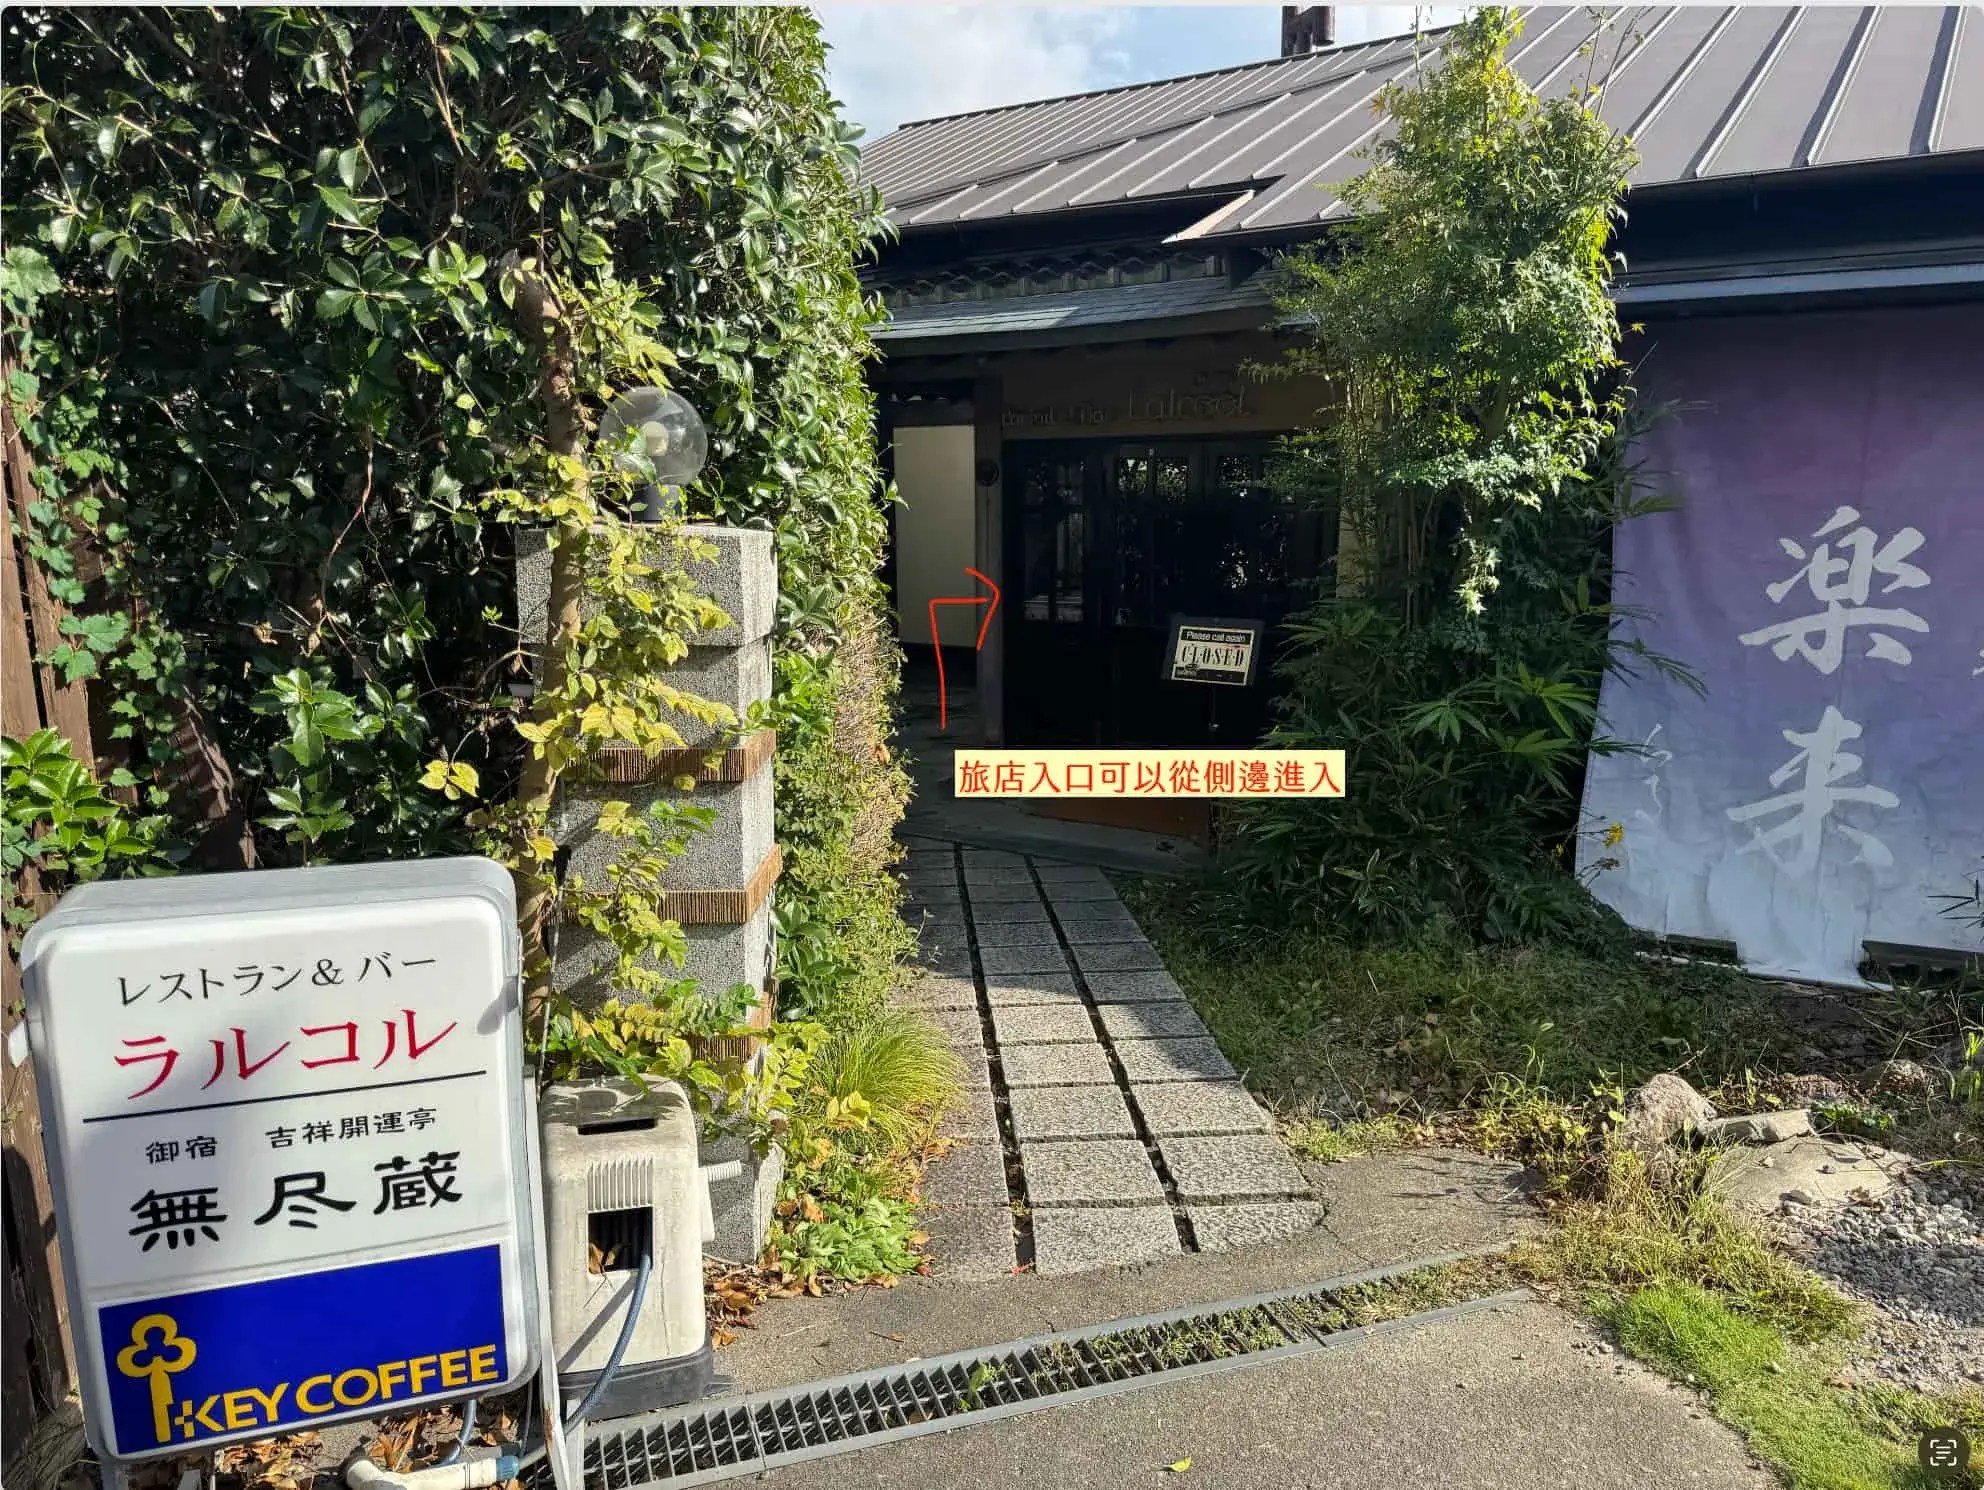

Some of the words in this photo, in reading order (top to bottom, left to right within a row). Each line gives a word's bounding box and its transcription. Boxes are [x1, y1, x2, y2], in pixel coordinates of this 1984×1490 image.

[113, 1008, 459, 1101] ラルコル
[145, 1135, 219, 1165] 御宿
[264, 1106, 438, 1150] 吉祥開運亭
[174, 1382, 291, 1438] KEY
[295, 1343, 499, 1414] COFFEE
